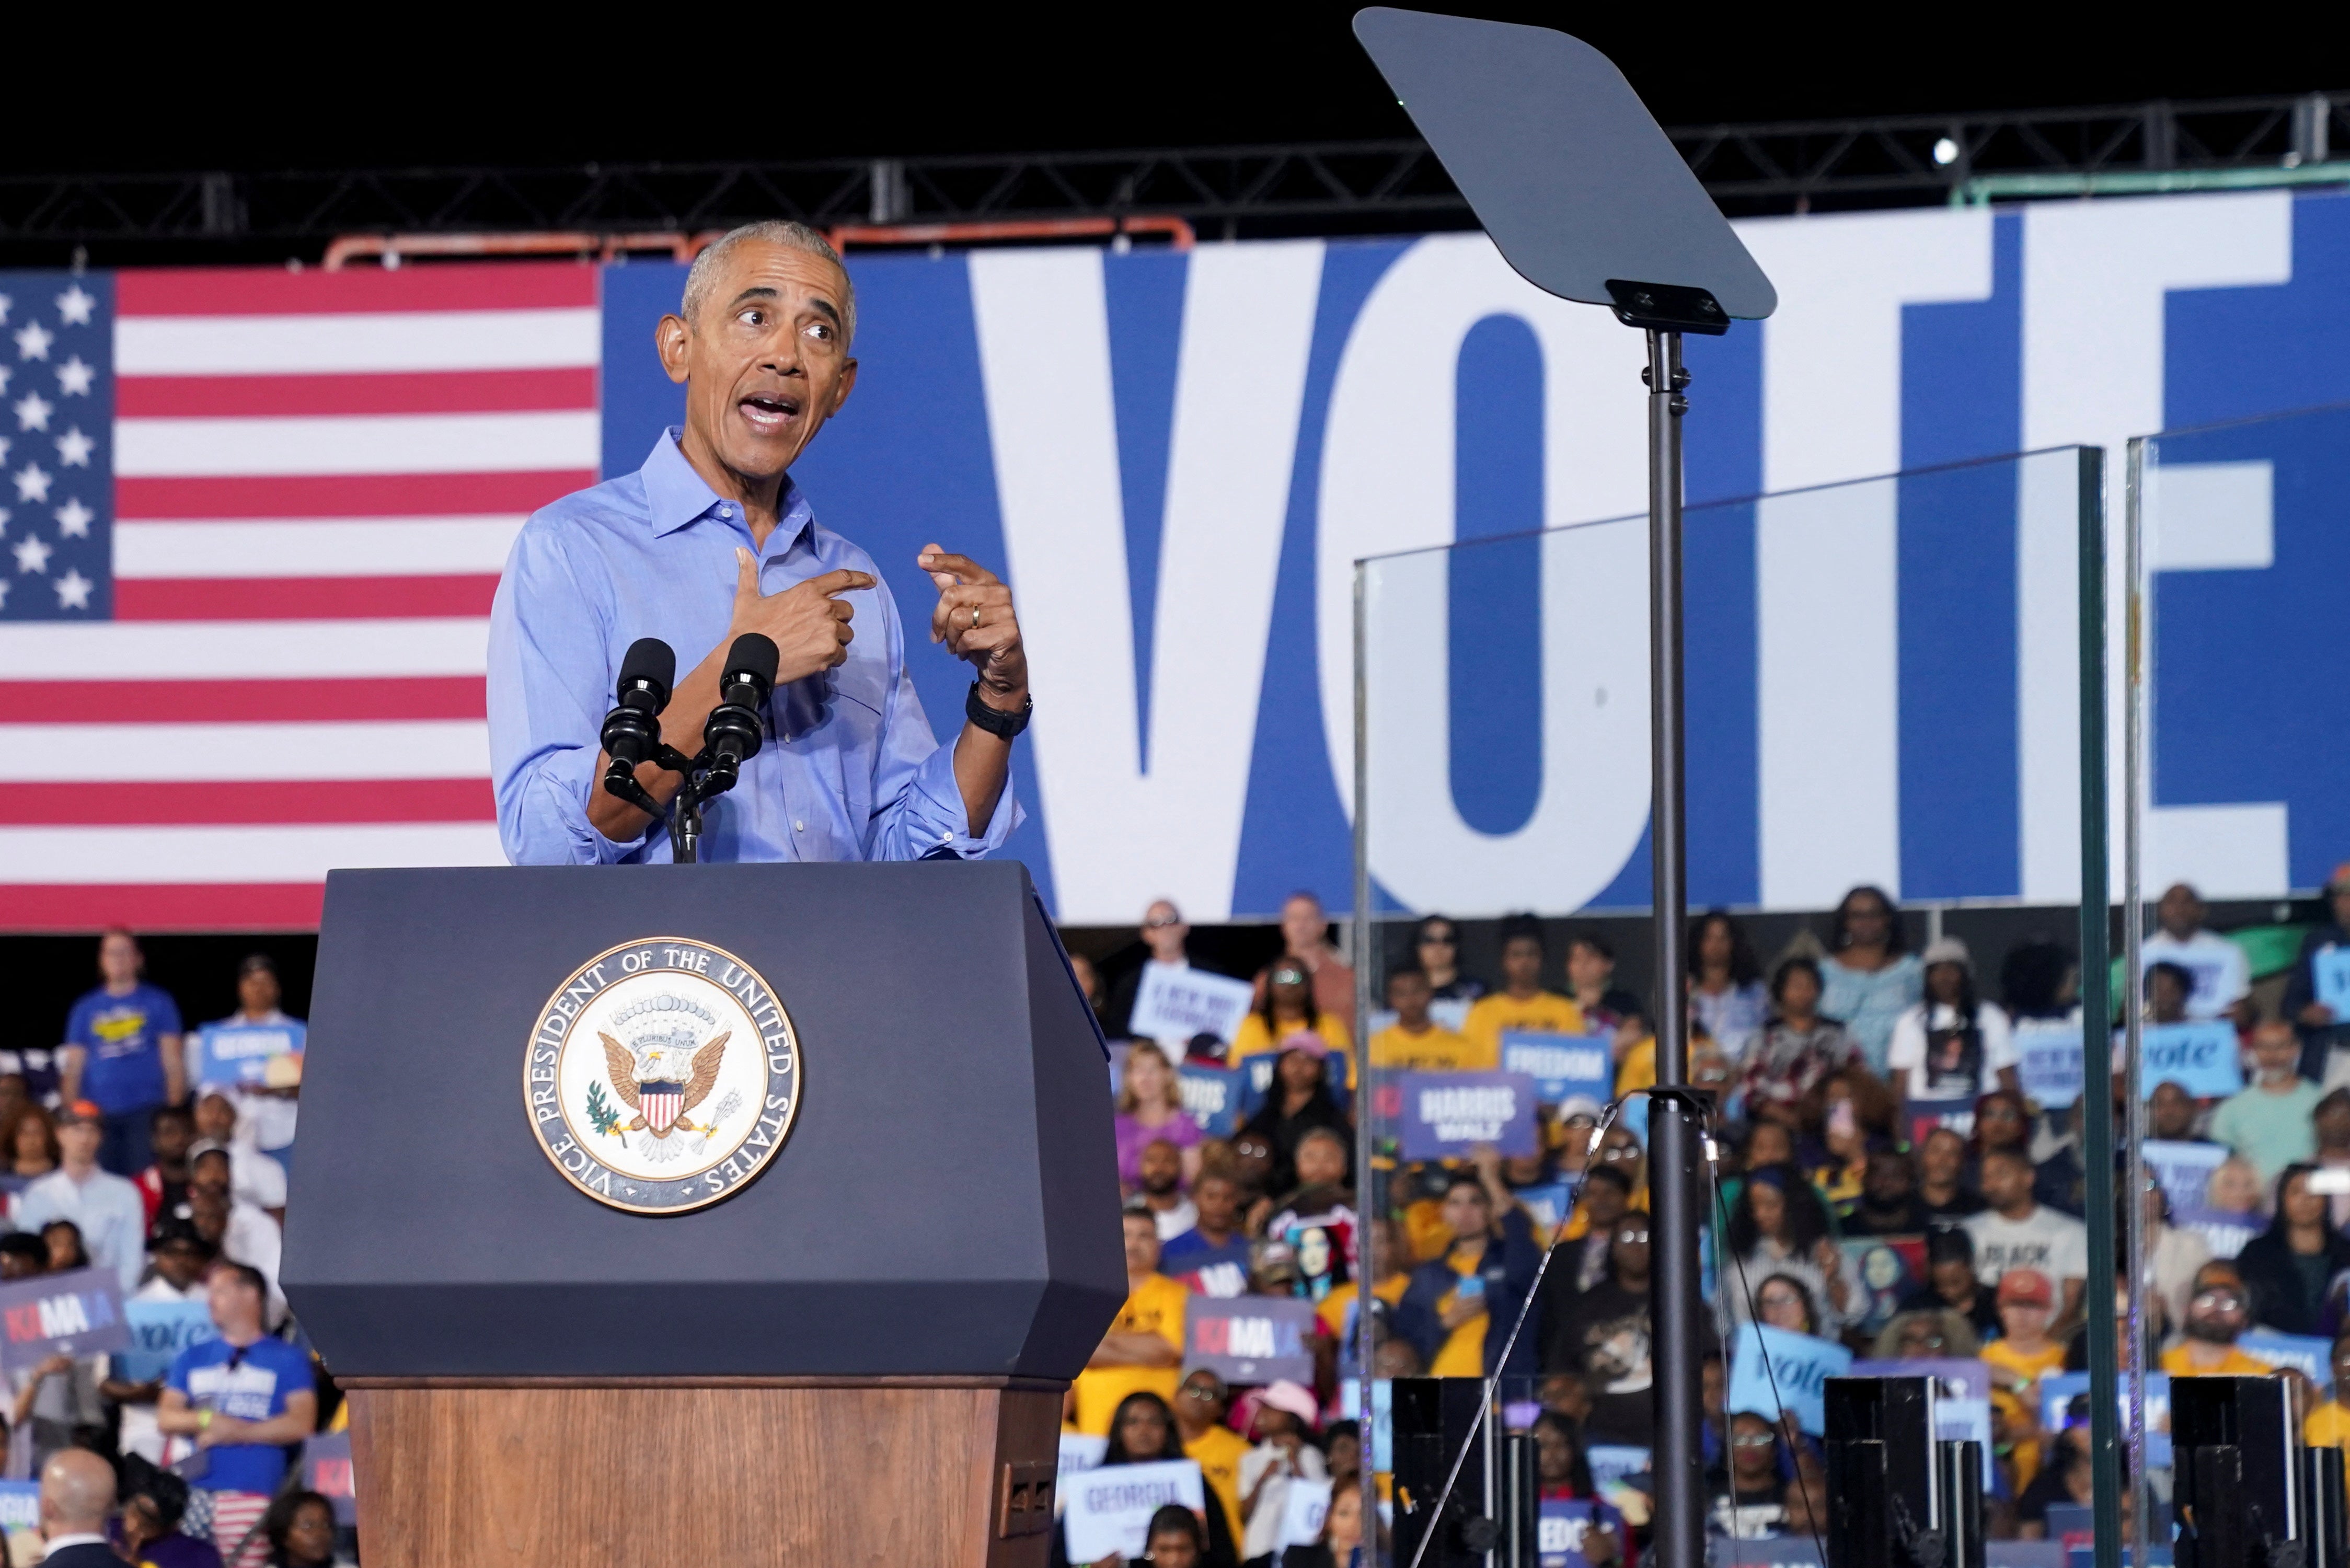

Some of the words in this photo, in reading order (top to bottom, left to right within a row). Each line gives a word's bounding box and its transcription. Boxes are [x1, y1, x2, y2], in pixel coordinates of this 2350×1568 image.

[969, 192, 2291, 923] VOTE
[622, 950, 654, 973] OF
[664, 948, 711, 974] THE
[638, 1035, 672, 1044] PLURIBUS
[722, 965, 793, 1075] UNITED
[531, 963, 608, 1123] PRESIDENT
[1419, 1086, 1516, 1124] HARRIS
[706, 1093, 789, 1193] STATES
[1434, 1121, 1505, 1143] WALZ
[551, 1133, 611, 1196] VICE
[1195, 1316, 1303, 1359] KAMALA
[1085, 1481, 1179, 1515] GEORGIA
